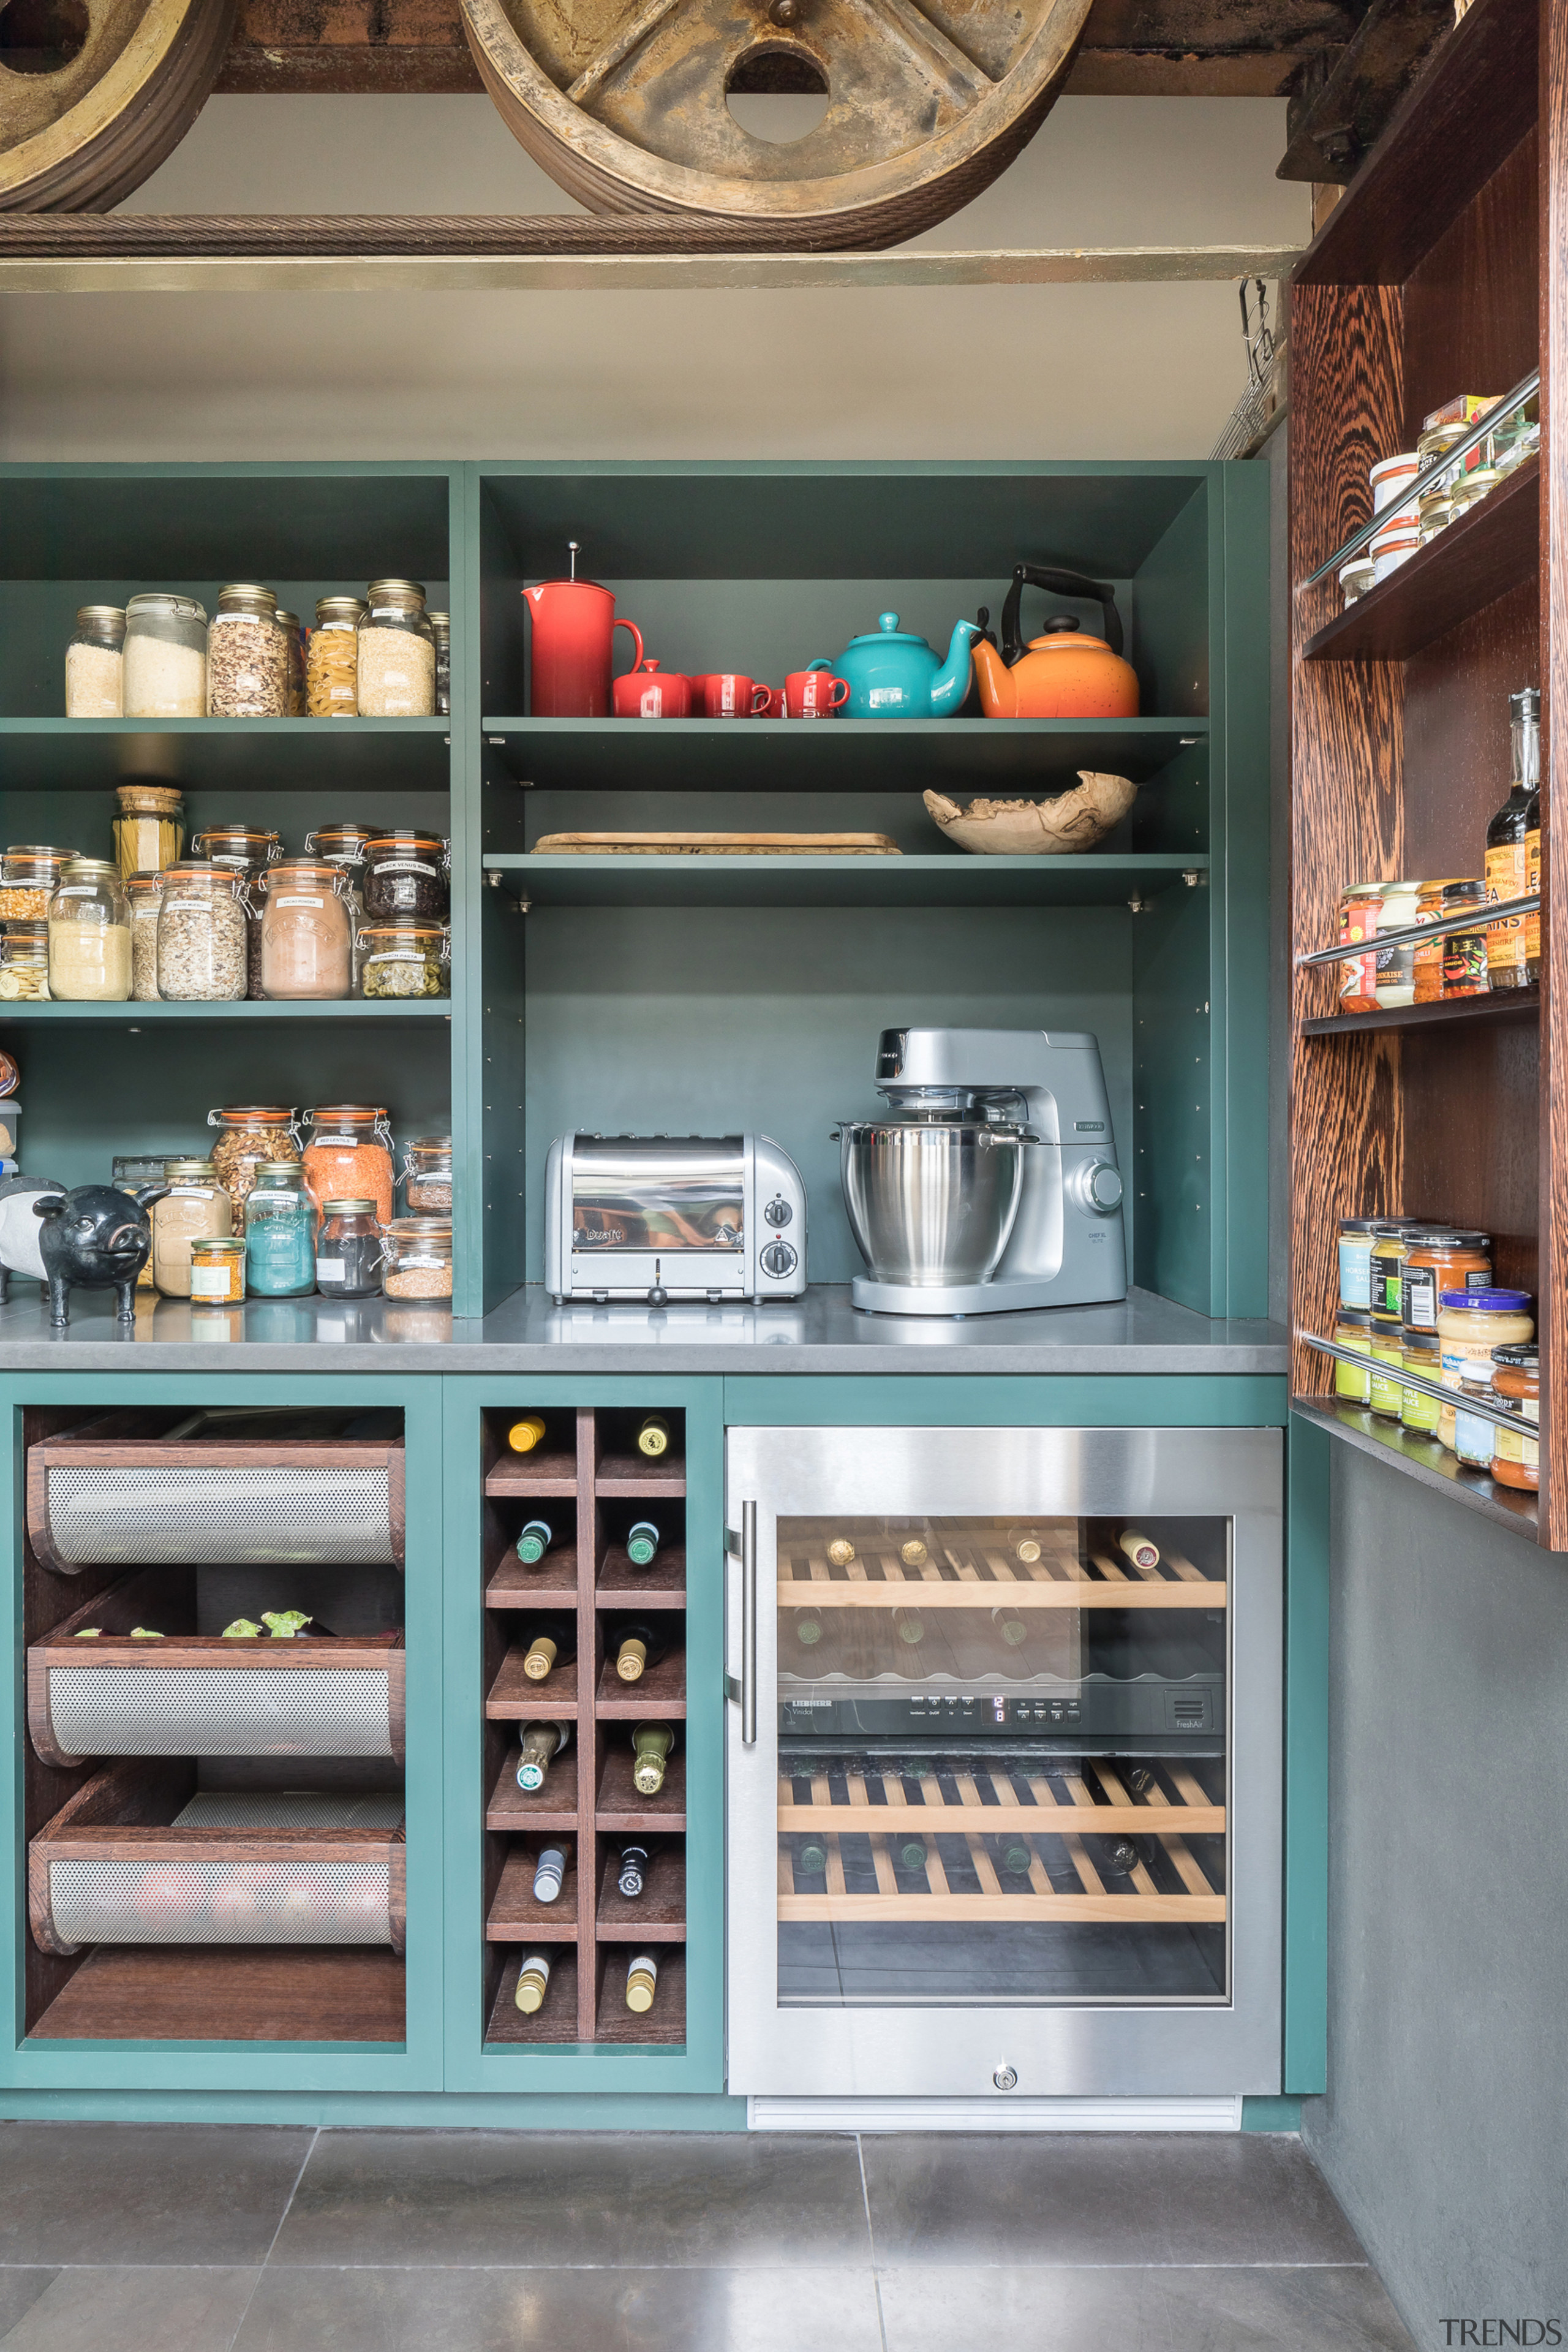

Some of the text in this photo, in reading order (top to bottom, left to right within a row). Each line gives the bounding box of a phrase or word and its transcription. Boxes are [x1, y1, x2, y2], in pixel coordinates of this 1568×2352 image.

[586, 1229, 623, 1240] Dualit
[993, 1696, 1005, 1707] 12
[996, 1711, 1005, 1722] 8
